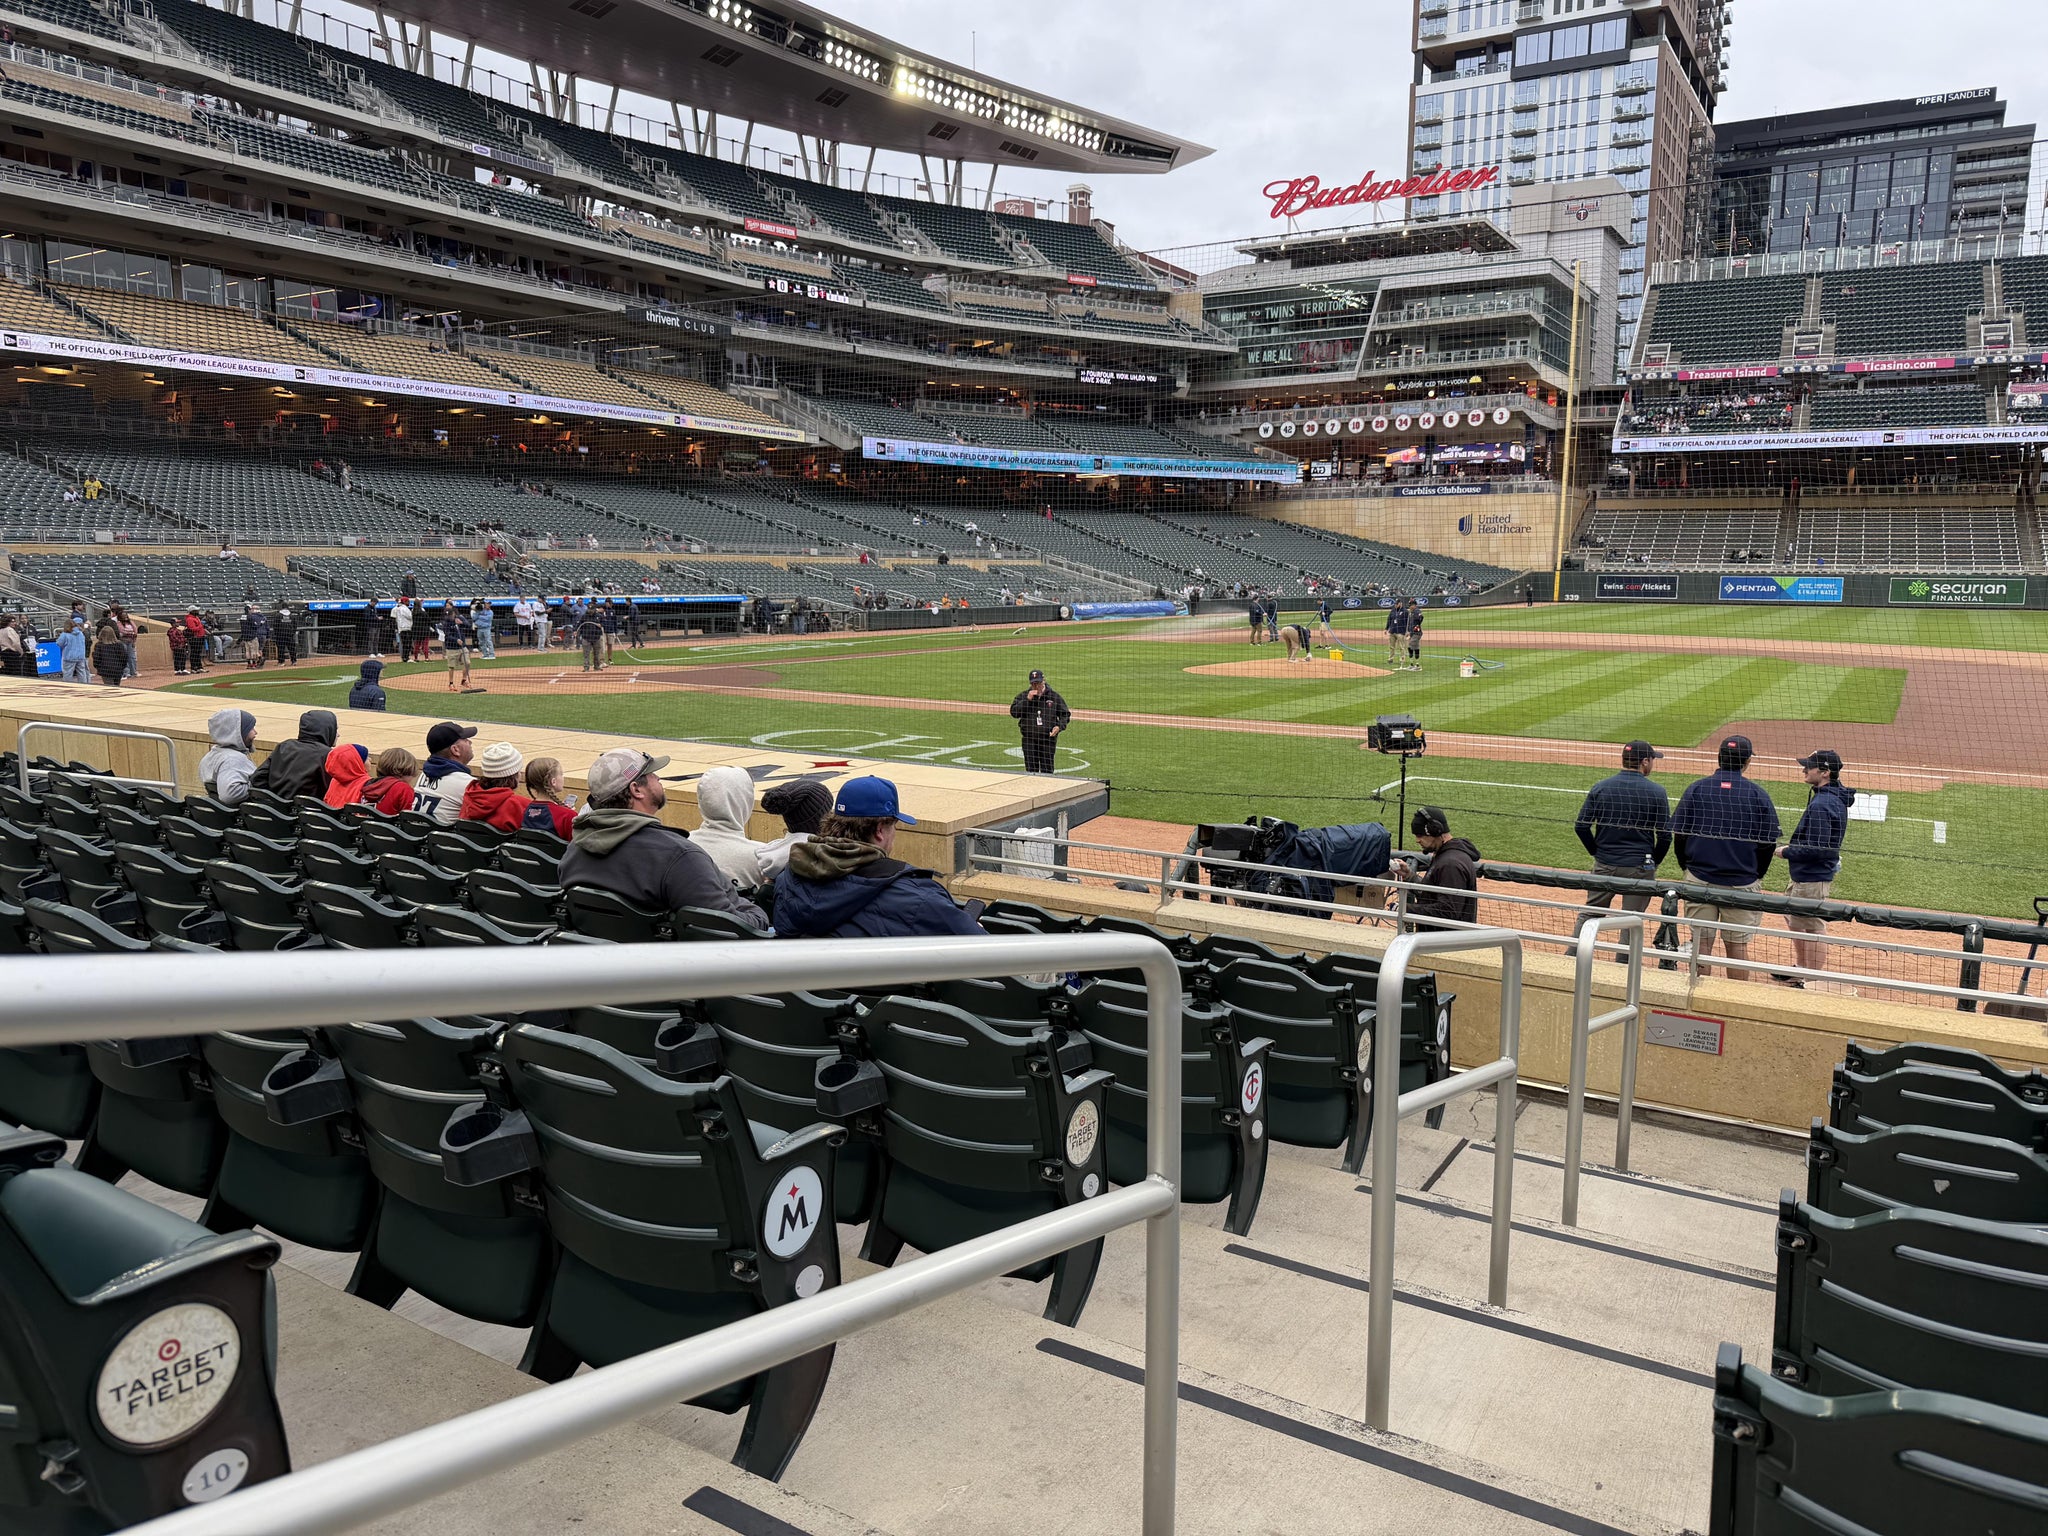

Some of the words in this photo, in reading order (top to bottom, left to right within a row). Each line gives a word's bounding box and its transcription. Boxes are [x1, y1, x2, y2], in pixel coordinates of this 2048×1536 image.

[1915, 95, 1942, 106] PIPER
[1948, 88, 1991, 102] SANDLER
[1263, 163, 1500, 218] Budweiser
[1004, 201, 1025, 215] Ford
[1220, 312, 1247, 322] WELCOME
[1265, 305, 1295, 319] TWINS
[646, 310, 680, 328] thrivent
[684, 319, 715, 335] CLUB
[49, 341, 66, 350] THE
[68, 344, 107, 355] OFFICIAL
[109, 349, 147, 359] ON-FIELD
[180, 358, 206, 367] MAJOR
[208, 361, 237, 370] LEAGUE
[1248, 351, 1260, 363] WE
[1262, 350, 1276, 362] ARE
[1278, 348, 1292, 361] ALL
[1688, 370, 1732, 379] Treasure
[1735, 367, 1767, 377] Island
[328, 374, 340, 382] THE
[342, 376, 371, 385] OFFICIAL
[372, 380, 401, 389] ON-FIELD
[424, 386, 444, 394] MAJOR
[445, 389, 467, 397] LEAGUE
[1352, 421, 1360, 430] 10
[1398, 418, 1408, 427] 34
[1422, 416, 1431, 425] 14
[1946, 432, 1980, 440] OFFICIAL
[921, 450, 949, 458] OFFICIAL
[950, 452, 977, 460] ON-FIELD
[998, 455, 1020, 464] MAJOR
[1020, 457, 1047, 465] LEAGUE
[1402, 487, 1436, 495] Carbliss
[1437, 484, 1481, 494] Clubhouse
[1478, 514, 1511, 524] United
[1478, 524, 1532, 534] Healthcare
[1736, 584, 1776, 593] PENTAIR
[1931, 583, 2007, 595] securian
[1693, 1029, 1717, 1037] BEWARE
[1693, 1034, 1717, 1042] OBJECTS
[1683, 1037, 1705, 1045] LEAVING
[1068, 1120, 1097, 1143] TARGET
[1071, 1132, 1092, 1151] FIELD
[108, 1341, 229, 1402] TARGET
[127, 1367, 215, 1415] FIELD
[200, 1463, 231, 1491] 10
